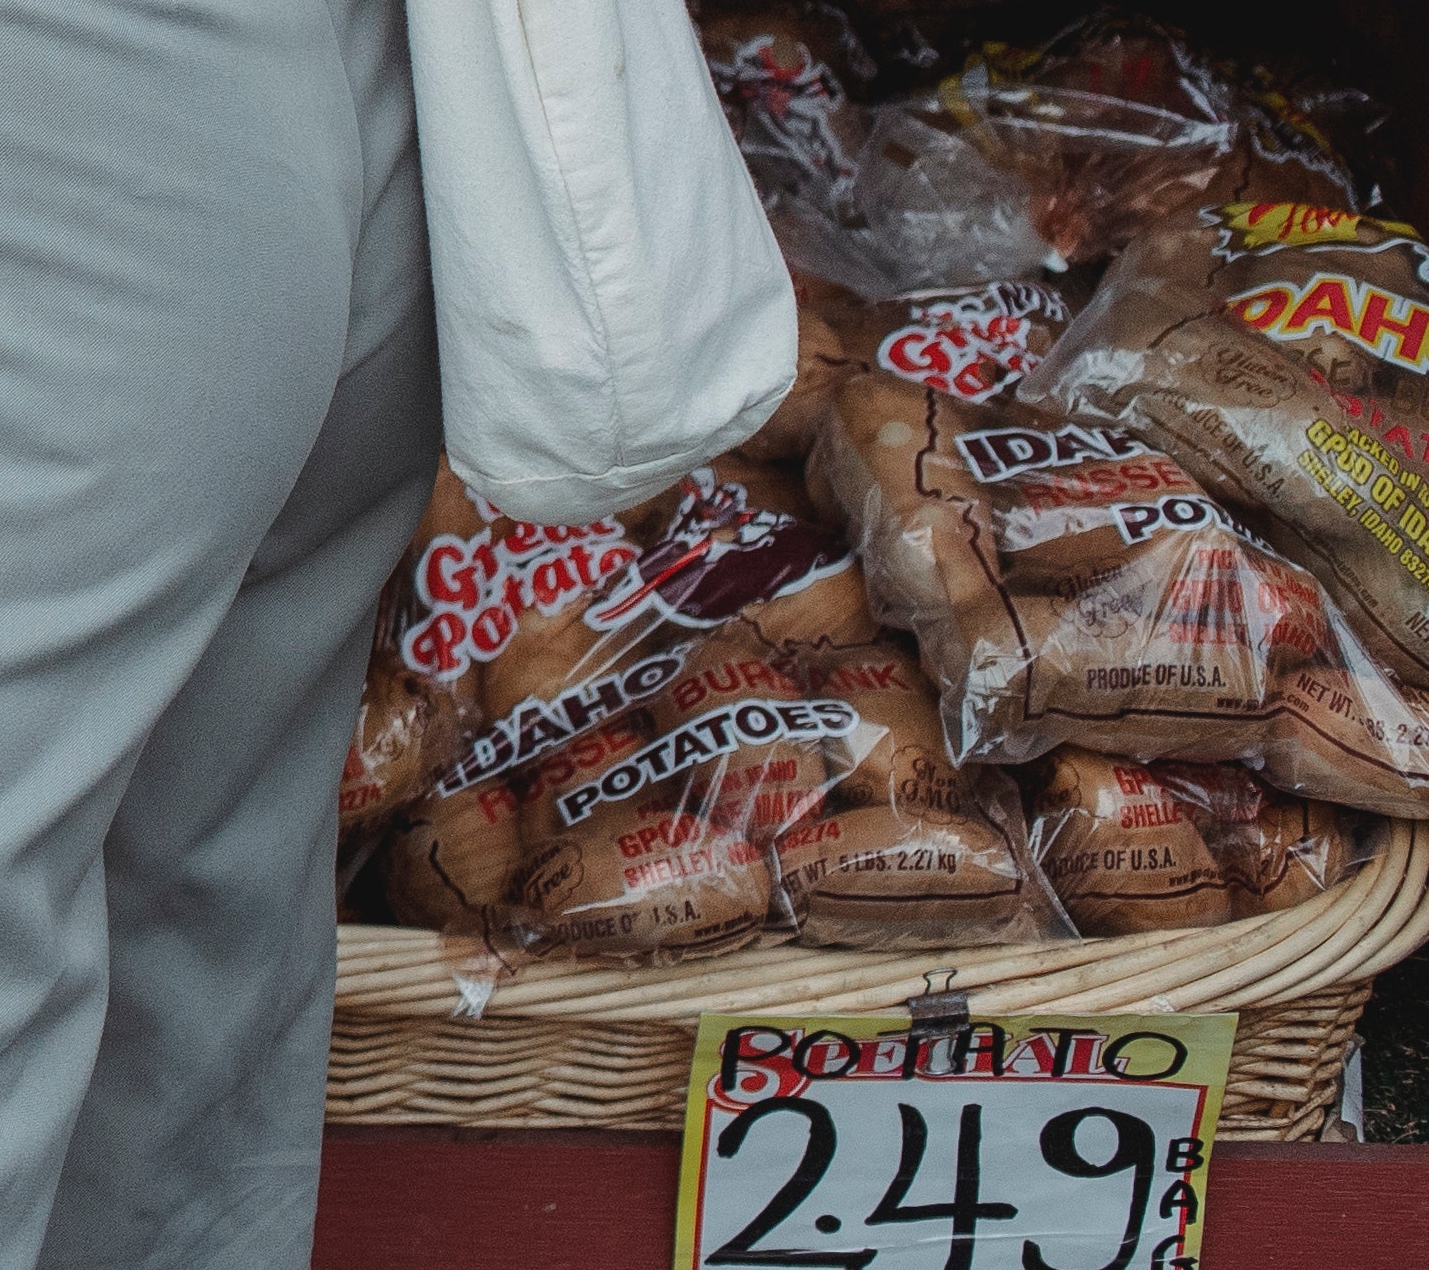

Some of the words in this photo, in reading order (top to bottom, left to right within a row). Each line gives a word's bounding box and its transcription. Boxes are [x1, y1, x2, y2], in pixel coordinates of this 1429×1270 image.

[1230, 275, 1429, 368] DAH
[1021, 458, 1191, 514] RUSSE
[1370, 472, 1406, 512] OF
[1398, 502, 1429, 556] IDA
[1359, 508, 1404, 555] IDAHO
[1399, 547, 1429, 593] 8327
[1405, 611, 1429, 641] NE
[1155, 663, 1177, 688] OF
[1296, 673, 1331, 703] NET
[559, 700, 859, 827] POTATOES
[896, 848, 933, 872] 2.27
[1103, 849, 1128, 871] OF
[1130, 846, 1177, 872] U.S.A.
[719, 1021, 1190, 1092] POTATO
[703, 1094, 1157, 1270] 2.49
